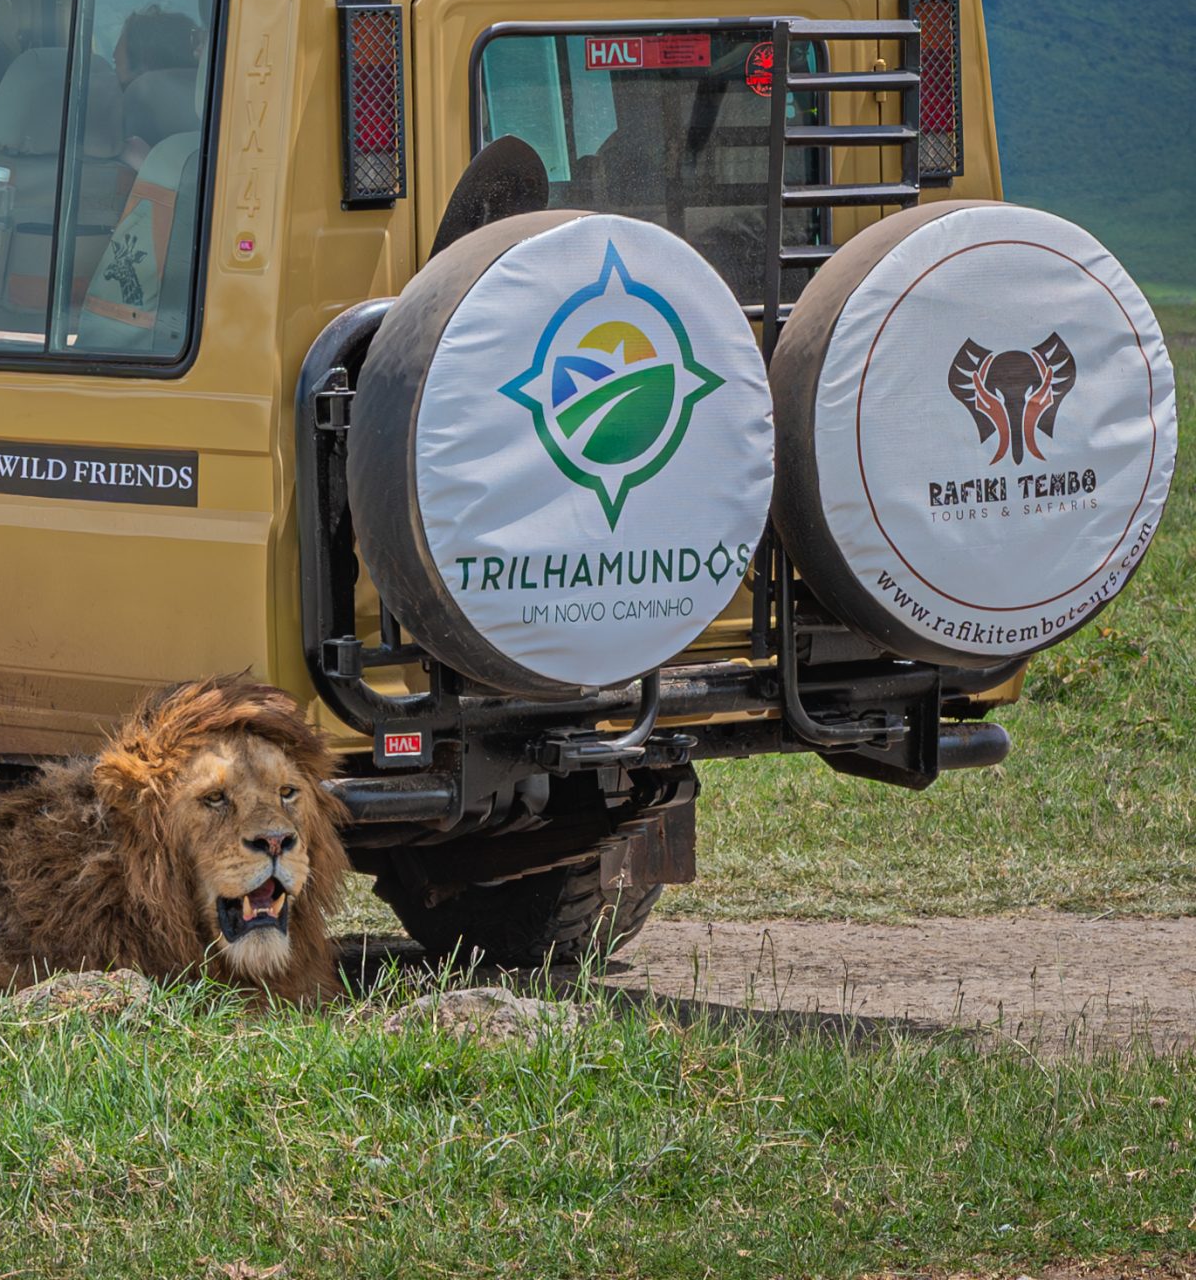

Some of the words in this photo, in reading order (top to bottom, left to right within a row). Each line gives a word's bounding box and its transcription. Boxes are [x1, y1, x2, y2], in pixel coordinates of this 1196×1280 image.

[591, 41, 637, 64] HAL
[72, 460, 194, 490] FRIENDS
[928, 476, 1007, 507] RAFIKI
[1017, 468, 1097, 499] TEMBO
[931, 508, 989, 523] TOURS
[1001, 506, 1010, 517] &
[1023, 498, 1098, 516] SAFARIS
[455, 541, 751, 591] TRILHAMUNDOS
[876, 521, 1153, 645] www.rafikitembotours.com
[522, 604, 549, 624] UM
[555, 601, 605, 624] NOVO
[612, 596, 694, 620] CAMINHO
[389, 737, 418, 752] HAL
